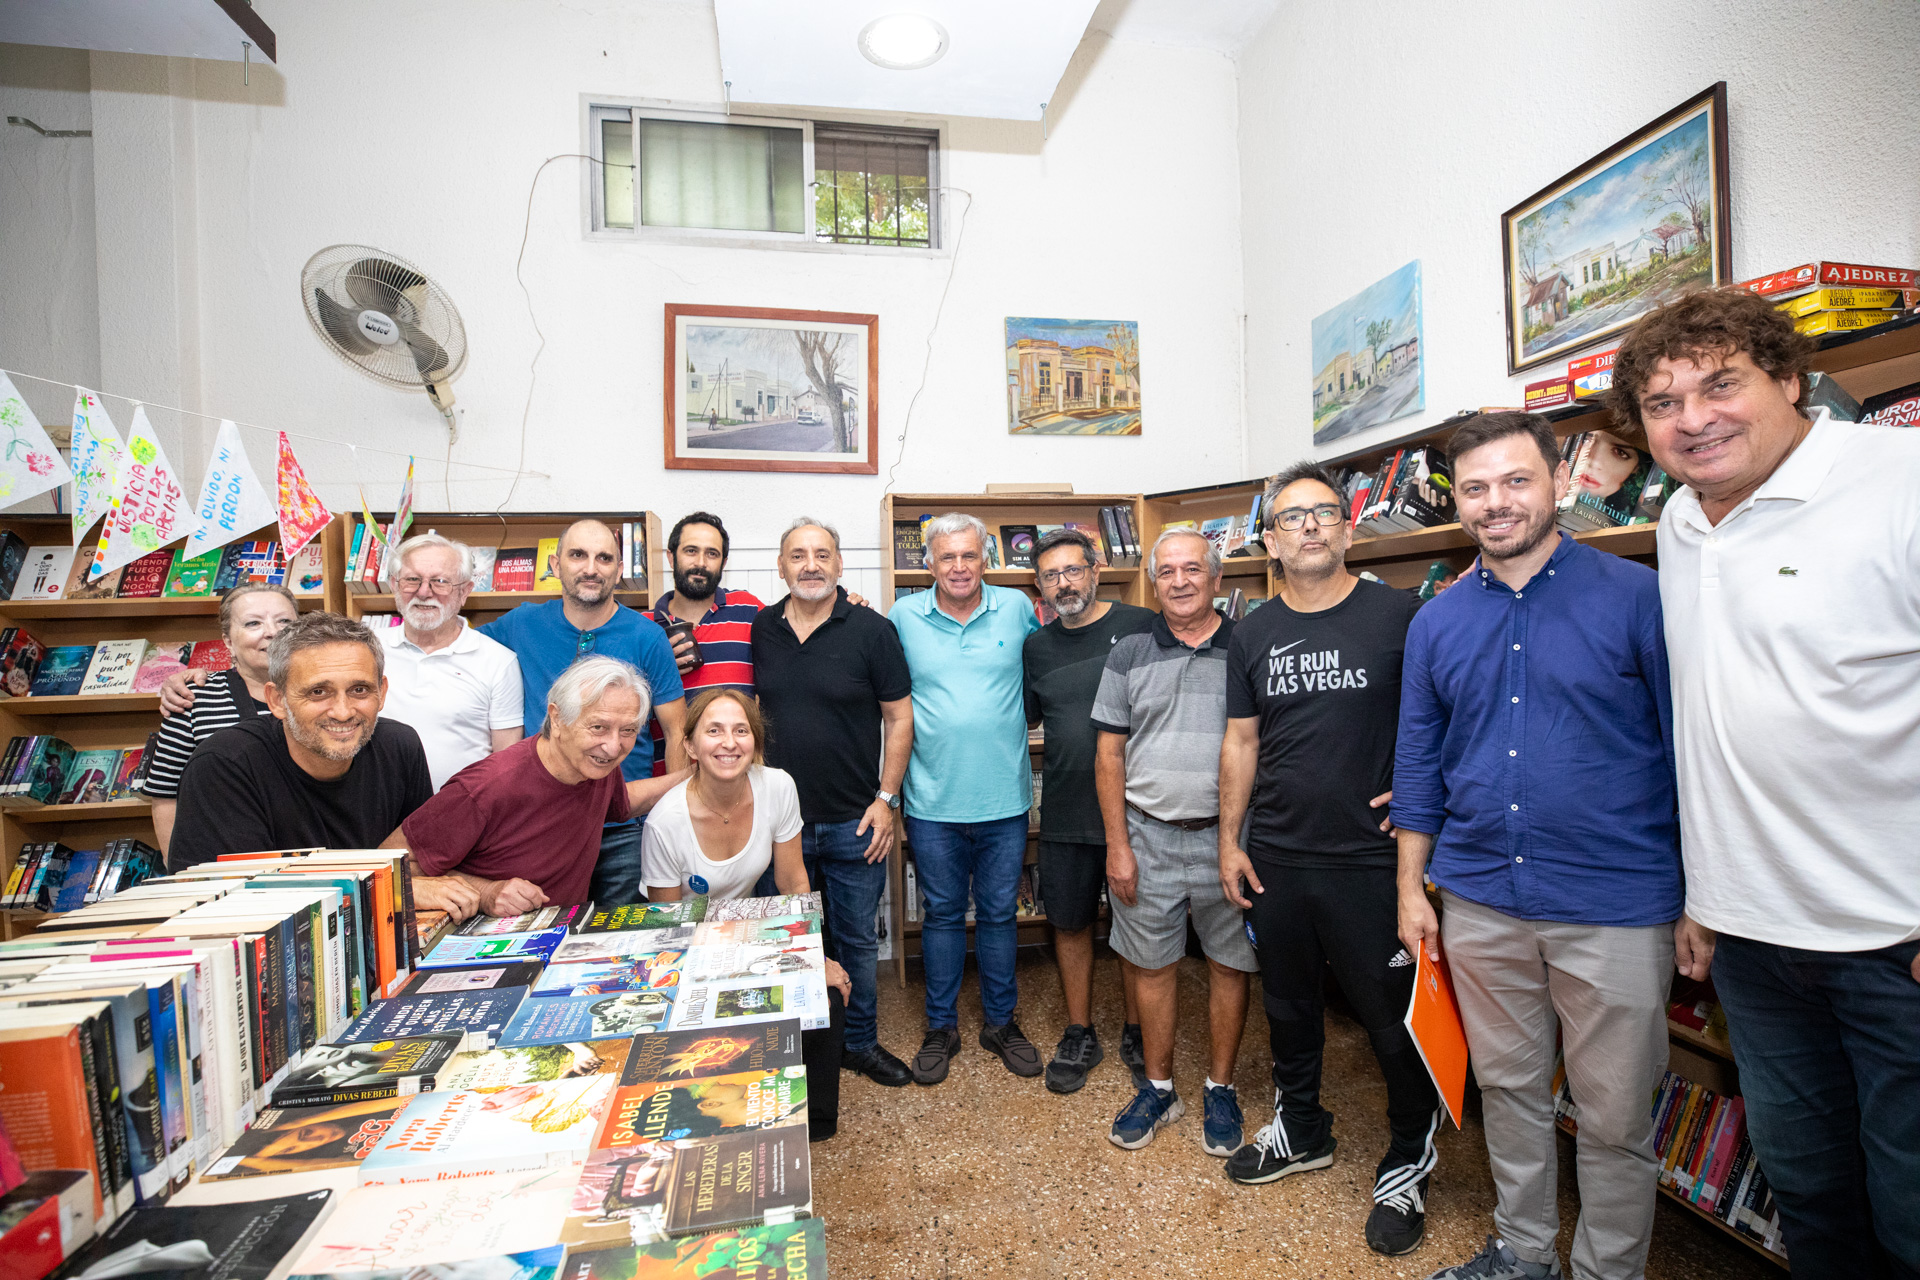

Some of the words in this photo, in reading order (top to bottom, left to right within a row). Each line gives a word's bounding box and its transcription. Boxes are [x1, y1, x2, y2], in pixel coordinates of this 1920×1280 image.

[1828, 266, 1910, 283] AJEDREZ
[1829, 297, 1856, 307] AJEDREZ
[1905, 291, 1911, 301] 2
[1836, 319, 1864, 328] AJEDREZ
[1574, 507, 1602, 525] LAUREN
[1580, 491, 1632, 526] delirium
[510, 565, 534, 573] CANCIÓN
[513, 558, 533, 566] ALMAS
[99, 665, 125, 674] pura
[114, 651, 132, 663] por
[1268, 655, 1295, 676] WE
[1300, 649, 1340, 673] RUN
[83, 679, 130, 691] casualidad
[1266, 675, 1299, 697] LAS
[1301, 668, 1368, 692] VEGAS
[590, 911, 610, 927] MARY
[607, 905, 631, 930] HIGGINS
[268, 935, 280, 1007] MARTYRIUM
[300, 942, 311, 993] ROMA
[1388, 958, 1415, 968] adida
[203, 966, 213, 1018] LUCINDA
[235, 979, 242, 991] SE
[236, 993, 245, 1031] VIENTO
[302, 995, 312, 1025] SOY
[383, 1004, 414, 1034] CUANDO
[395, 1026, 413, 1037] NO
[412, 998, 435, 1027] QUEDEN
[430, 997, 465, 1034] ESTRELLAS
[456, 1006, 475, 1021] QUE
[467, 1000, 494, 1025] CONTAR
[531, 1002, 560, 1040] ROMANCES
[544, 1002, 570, 1038] ARGENTINOS
[566, 1000, 589, 1036] TURBULENTOS
[206, 1020, 215, 1052] RILEY
[766, 1026, 779, 1052] NADIE
[239, 1042, 247, 1060] QUE
[377, 1041, 421, 1075] DIVAS
[637, 1035, 670, 1085] KENYON
[750, 1051, 763, 1070] HIJO
[240, 1061, 248, 1073] LO
[278, 1097, 306, 1106] CRISTINA
[307, 1094, 331, 1103] MORATÓ
[333, 1091, 360, 1102] DIVAS
[747, 1081, 761, 1113] VIENTO
[761, 1088, 776, 1130] CONOCE
[777, 1080, 792, 1121] NOMBRE
[408, 1094, 468, 1153] Roberts
[610, 1093, 645, 1147] ISABEL
[746, 1114, 760, 1128] EL
[383, 1117, 426, 1151] Nora
[758, 1142, 766, 1165] RIVERA
[684, 1171, 697, 1188] LAS
[696, 1144, 719, 1213] HEREDERAS
[720, 1174, 732, 1187] DE
[722, 1162, 733, 1174] LA
[736, 1150, 753, 1193] SINGER
[758, 1165, 766, 1184] LENA
[758, 1184, 766, 1198] ANA
